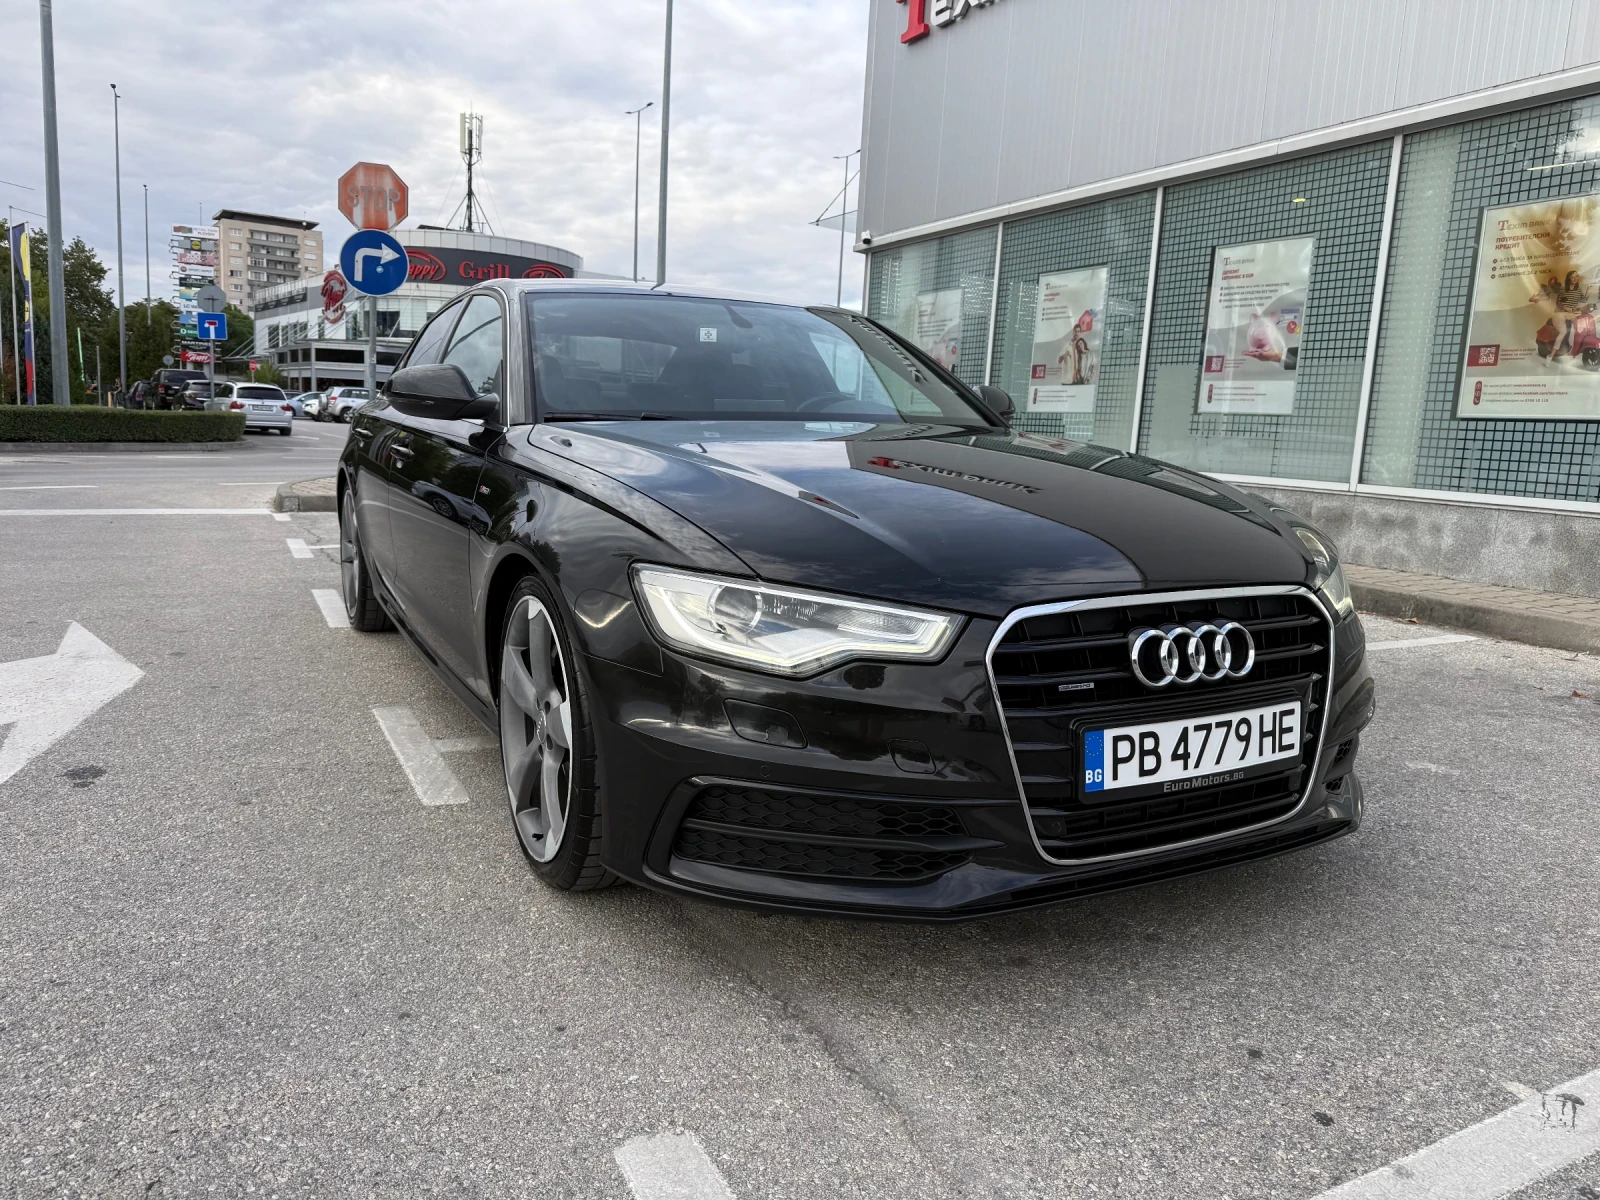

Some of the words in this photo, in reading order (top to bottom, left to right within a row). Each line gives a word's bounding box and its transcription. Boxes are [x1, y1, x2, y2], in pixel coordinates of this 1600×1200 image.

[346, 184, 401, 211] STOP
[1496, 232, 1550, 243] ПОТРЕБИТЕЛСКИ
[407, 263, 440, 281] appy
[459, 261, 510, 280] Grill
[1112, 730, 1162, 781] PB
[1170, 717, 1252, 771] 4779
[1258, 708, 1296, 756] HE
[1085, 768, 1103, 784] BG
